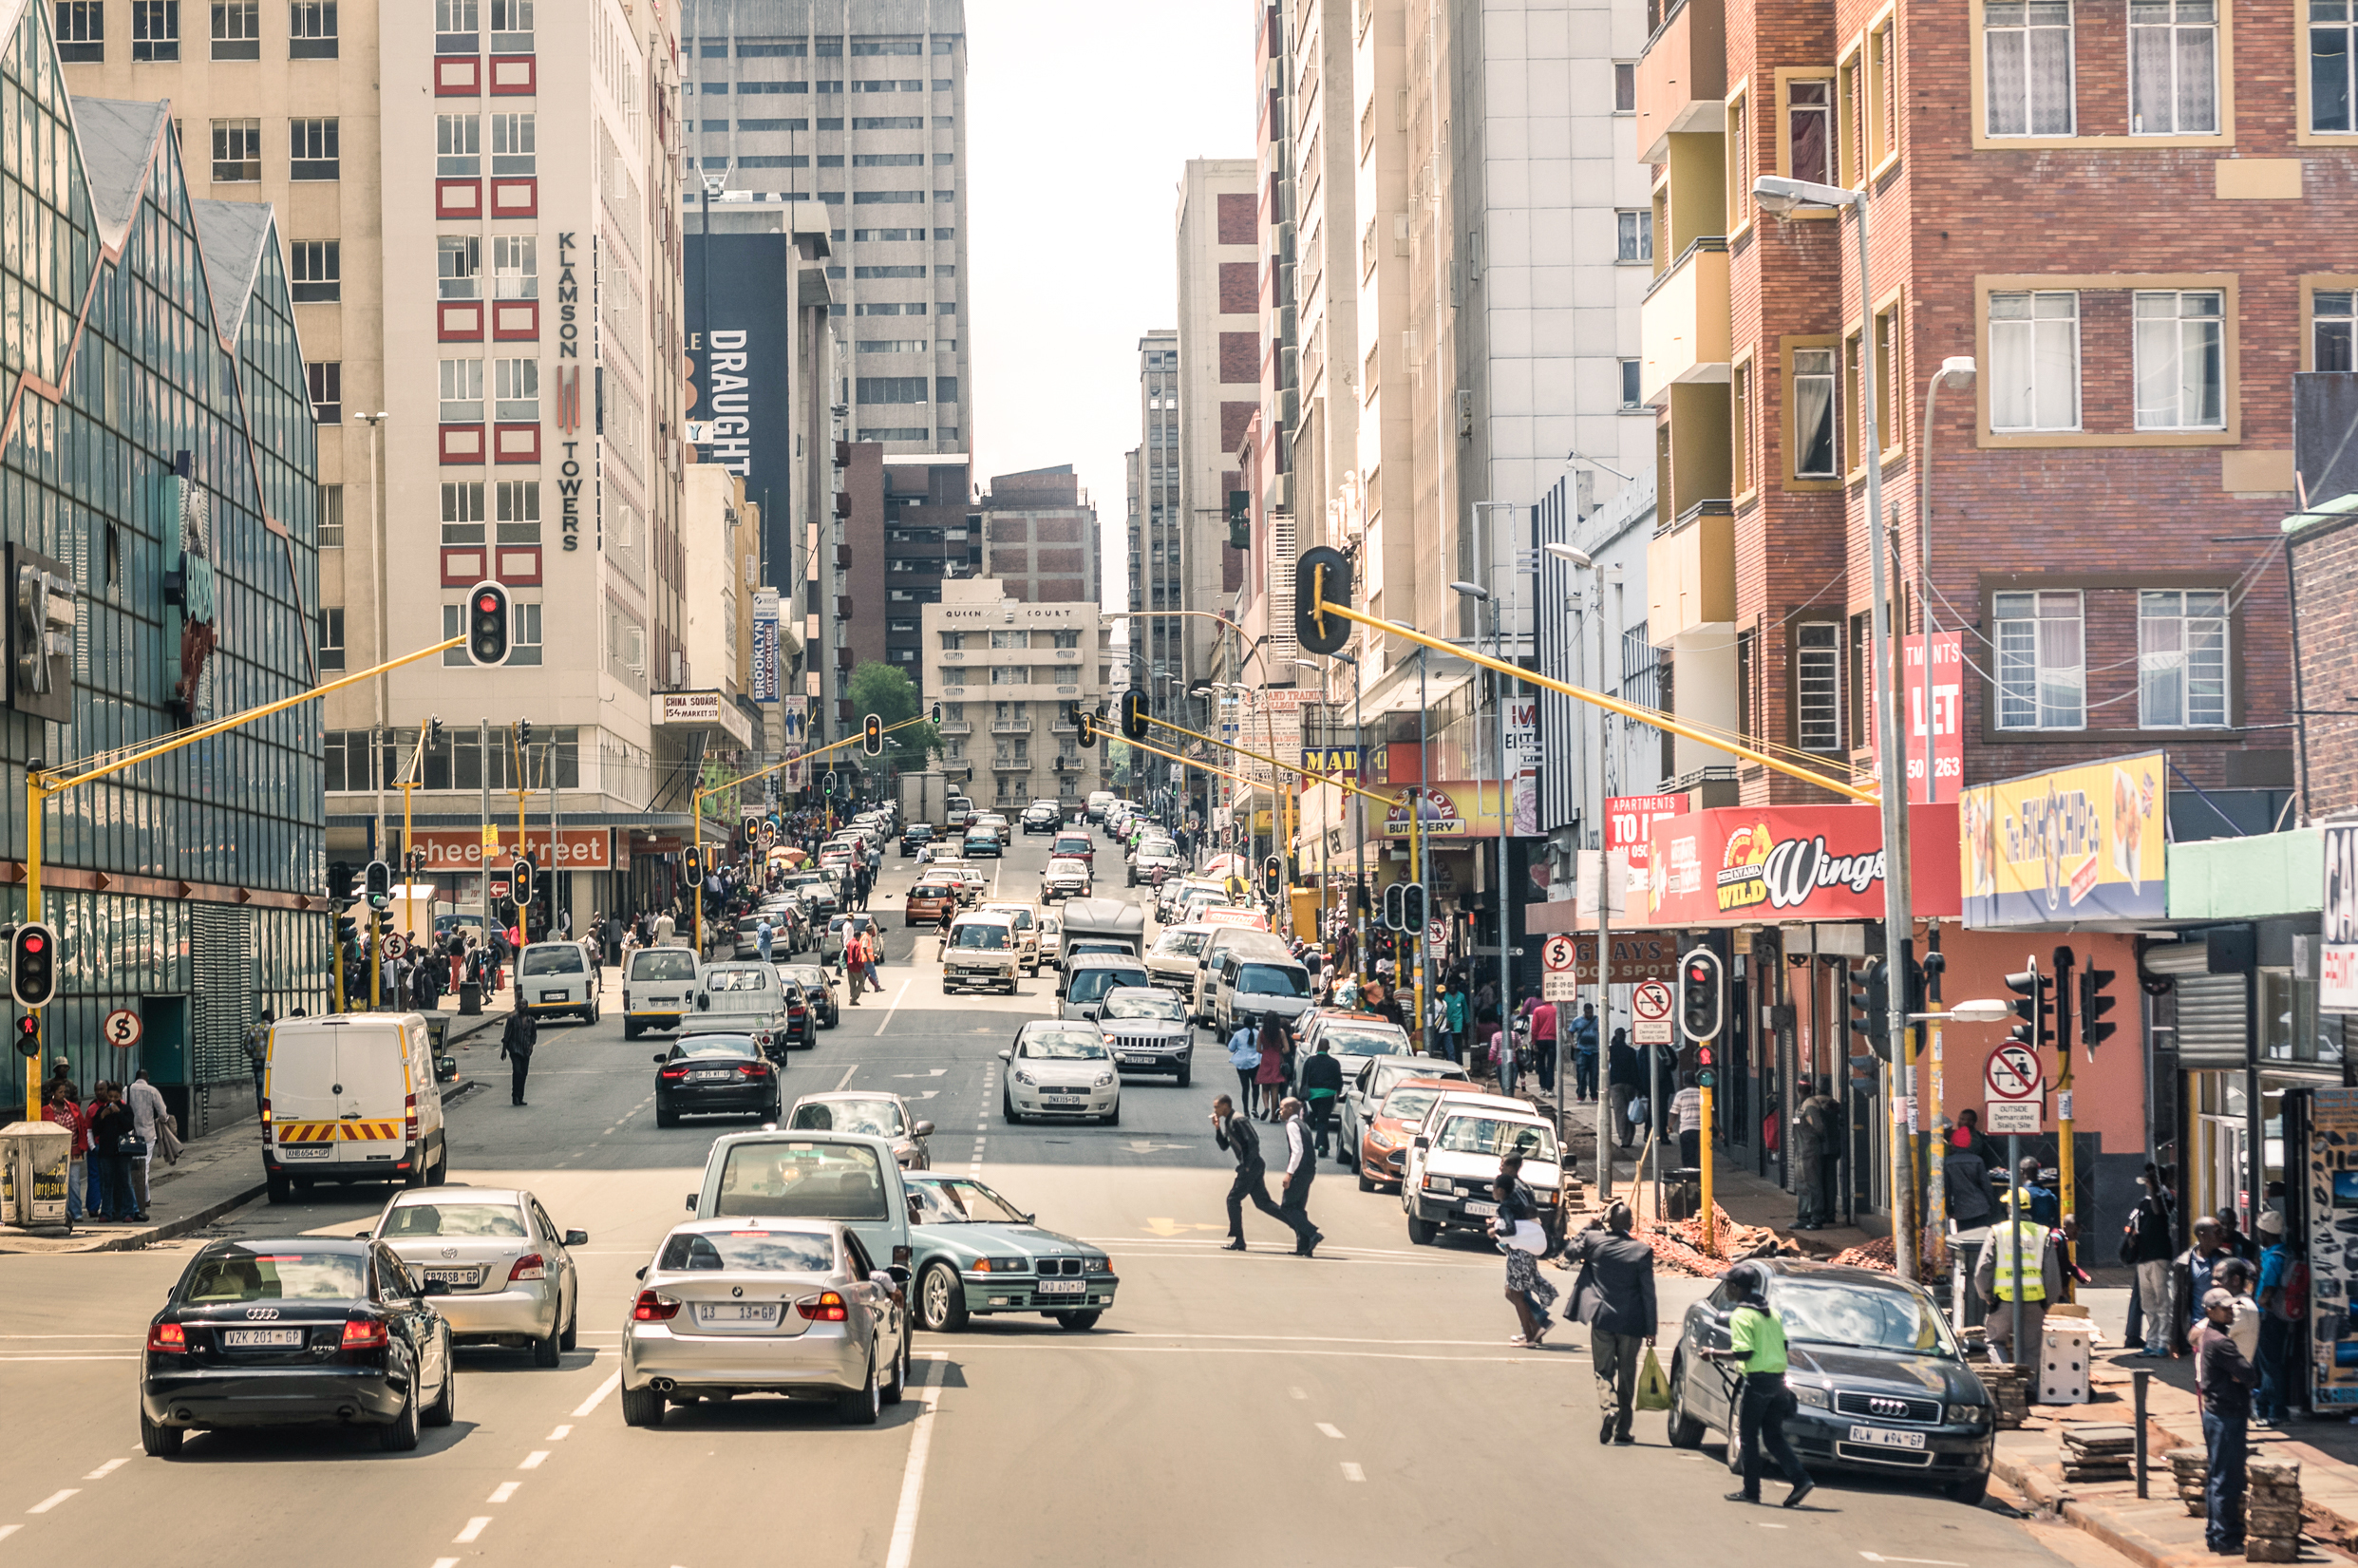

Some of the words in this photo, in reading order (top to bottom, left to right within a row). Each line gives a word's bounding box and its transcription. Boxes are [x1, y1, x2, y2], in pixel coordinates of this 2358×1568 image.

[558, 232, 578, 358] KLAMSON
[710, 330, 750, 477] DRAUGHT
[556, 442, 583, 552] TOWERS
[754, 620, 764, 700] BROOKLYN
[666, 698, 687, 707] CHINA
[690, 697, 718, 707] SQUARE
[666, 708, 681, 717] 154
[1913, 684, 1959, 737] LET
[1305, 751, 1361, 771] MAD
[1613, 797, 1675, 812] APARTMENTS
[1613, 813, 1638, 843] TO
[2058, 789, 2086, 859] CHIP
[1717, 879, 1767, 911] WILD
[1763, 836, 1887, 909] Wings
[1622, 964, 1671, 976] SPOT
[466, 1272, 478, 1282] GP
[740, 1307, 752, 1319] 13
[762, 1307, 775, 1319] GP
[229, 1331, 249, 1344] VZK
[254, 1331, 273, 1344] 201
[286, 1331, 299, 1344] GP
